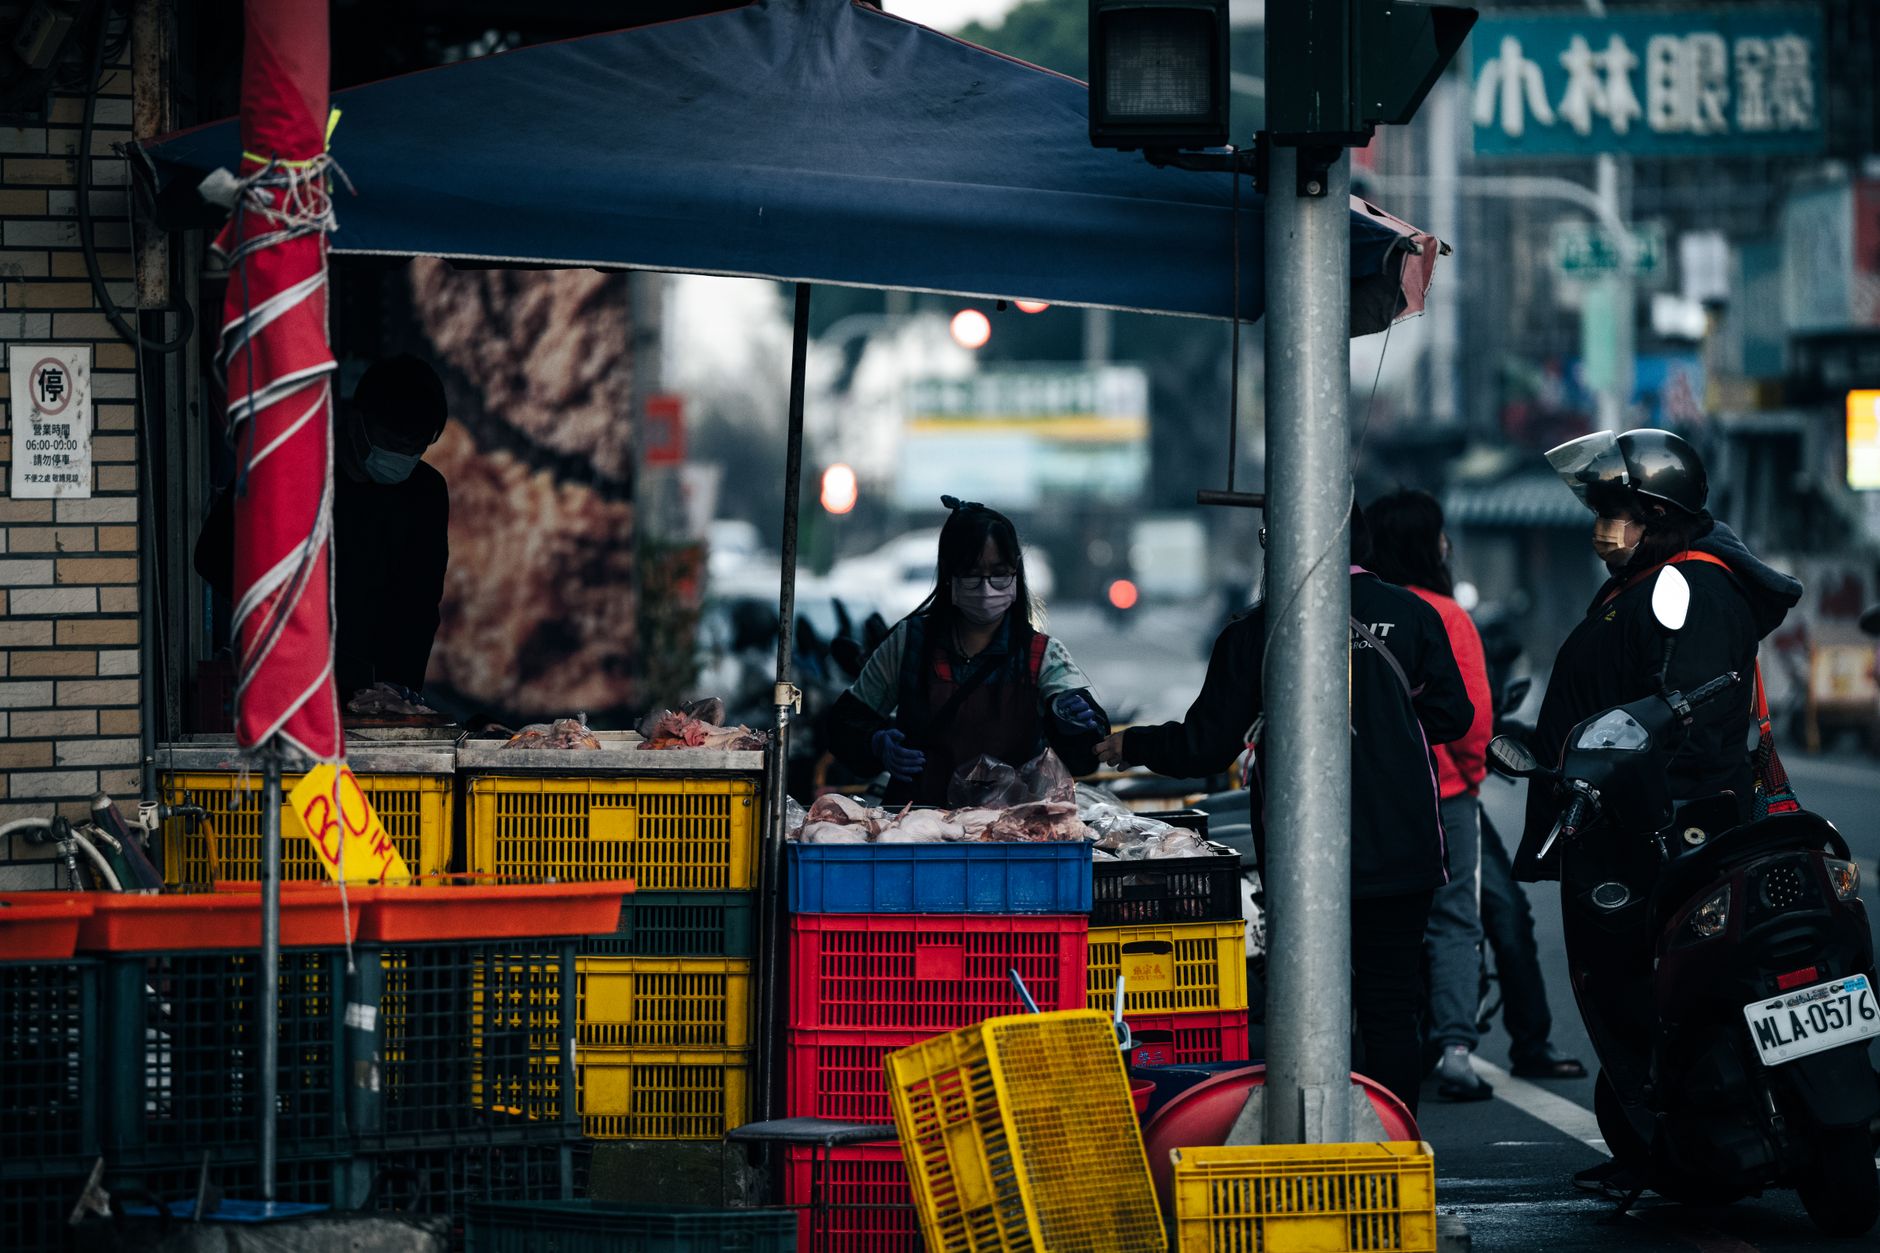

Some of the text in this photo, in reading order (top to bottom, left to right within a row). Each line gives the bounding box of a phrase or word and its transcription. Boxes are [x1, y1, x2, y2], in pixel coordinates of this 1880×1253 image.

[38, 368, 63, 402] 停
[33, 424, 70, 436] 營業時間
[33, 454, 70, 466] 請勿停車
[304, 769, 369, 865] 80
[1754, 990, 1875, 1050] MLA-0576
